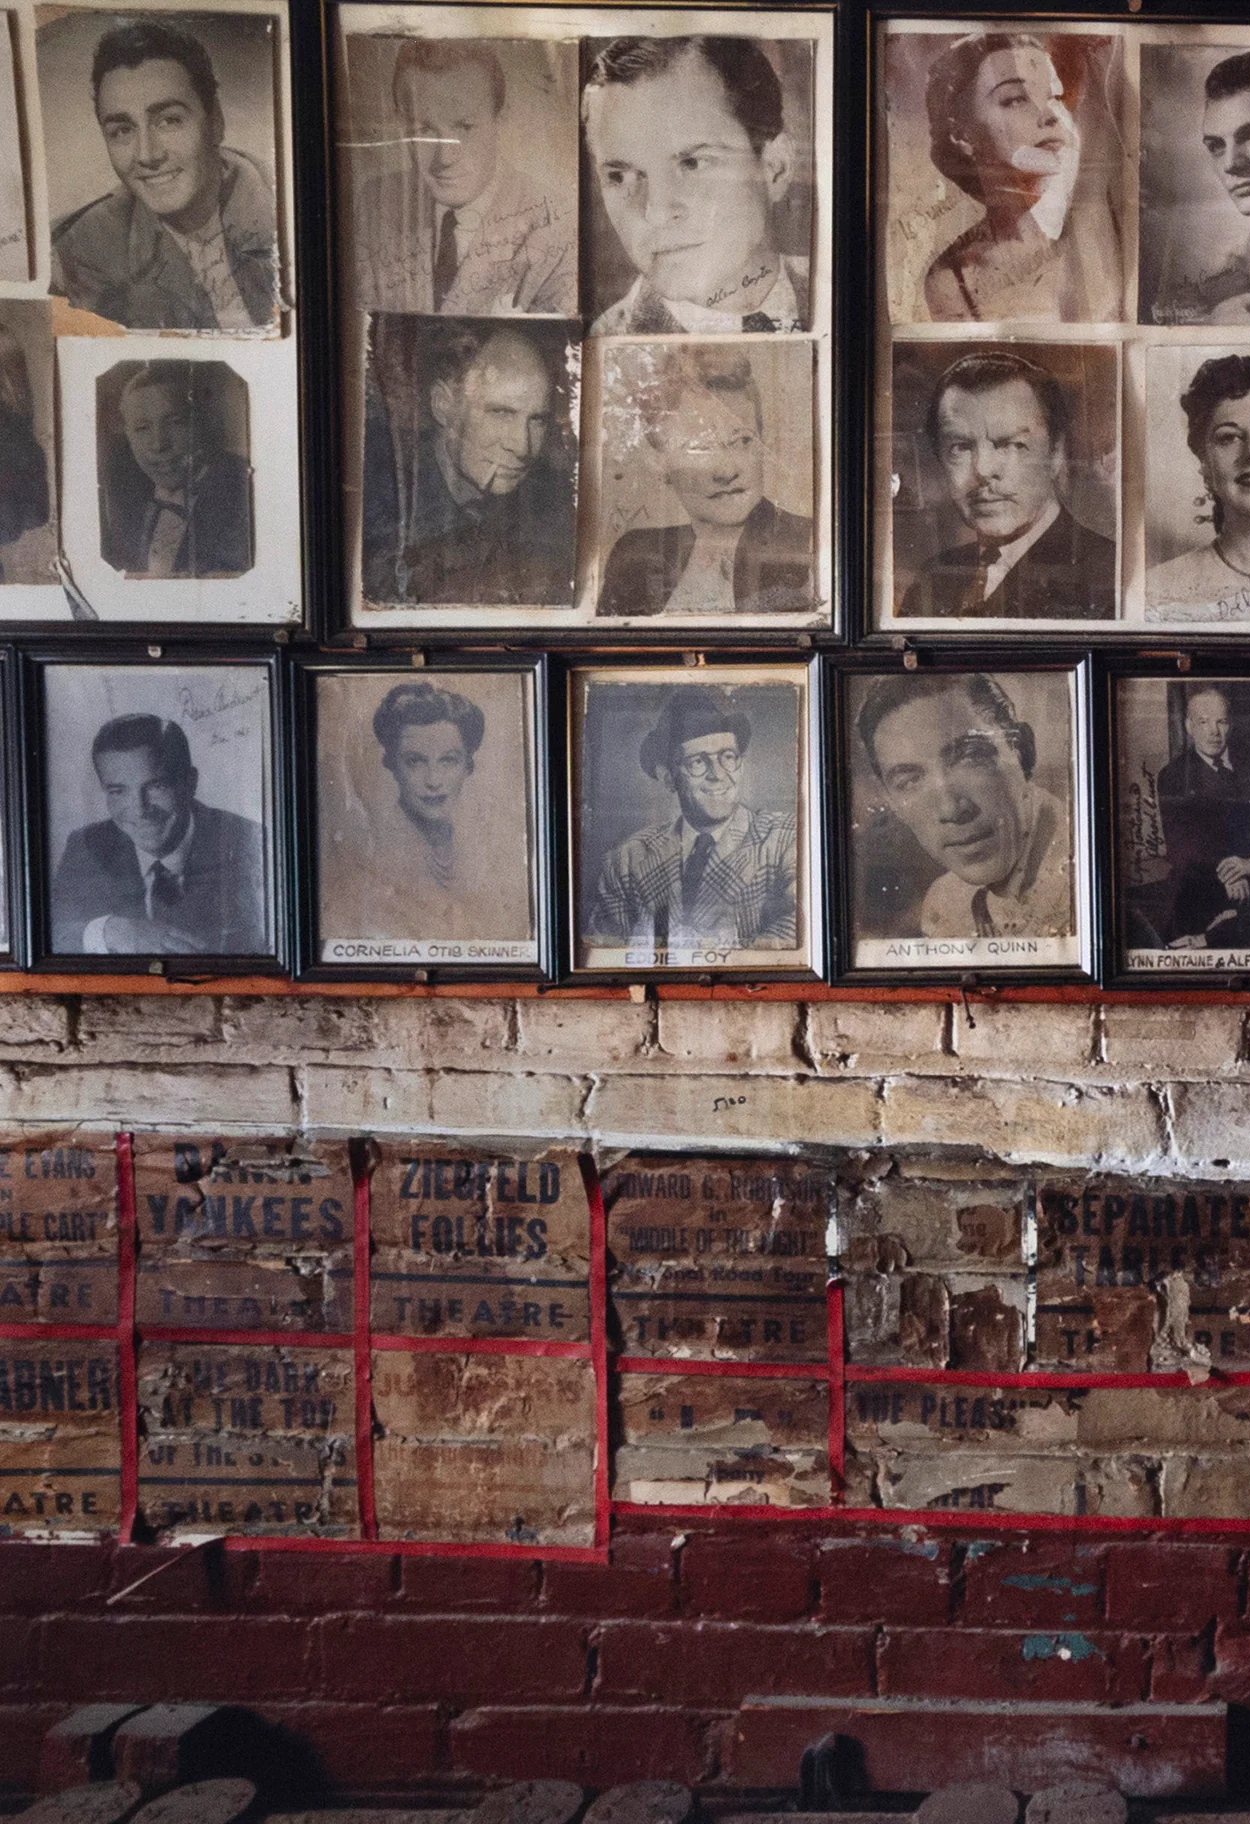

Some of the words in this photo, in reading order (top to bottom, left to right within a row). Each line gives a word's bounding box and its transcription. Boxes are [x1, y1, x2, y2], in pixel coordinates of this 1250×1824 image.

[333, 944, 421, 958] CORNELIA
[625, 952, 678, 965] EDDIE
[691, 951, 732, 964] FOY
[886, 942, 978, 957] ANTHONY
[987, 940, 1038, 955] QUINN
[25, 1148, 96, 1179] EVANS
[146, 1196, 344, 1240] YANKEES
[411, 1215, 547, 1259] FOLLIES
[393, 1297, 574, 1328] THEATRE
[4, 1492, 98, 1515] ATRE
